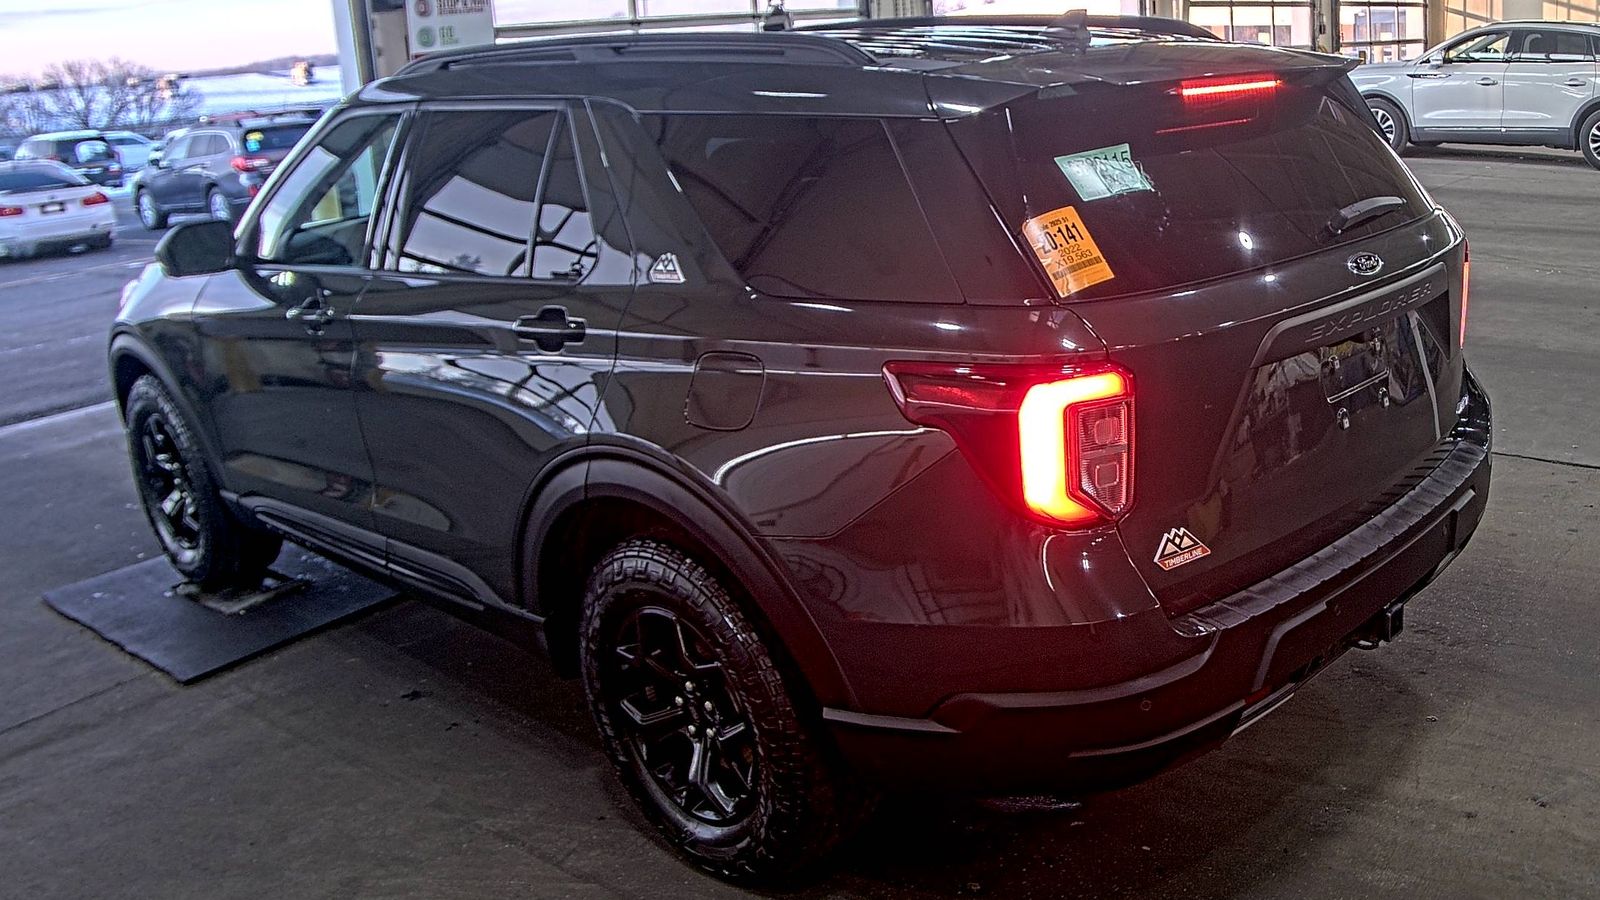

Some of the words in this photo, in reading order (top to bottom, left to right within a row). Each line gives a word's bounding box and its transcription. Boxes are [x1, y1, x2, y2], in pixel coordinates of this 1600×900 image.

[1058, 243, 1083, 257] 2022
[1304, 281, 1433, 343] EXPLORER
[1163, 547, 1203, 568] TIMBERLINE
